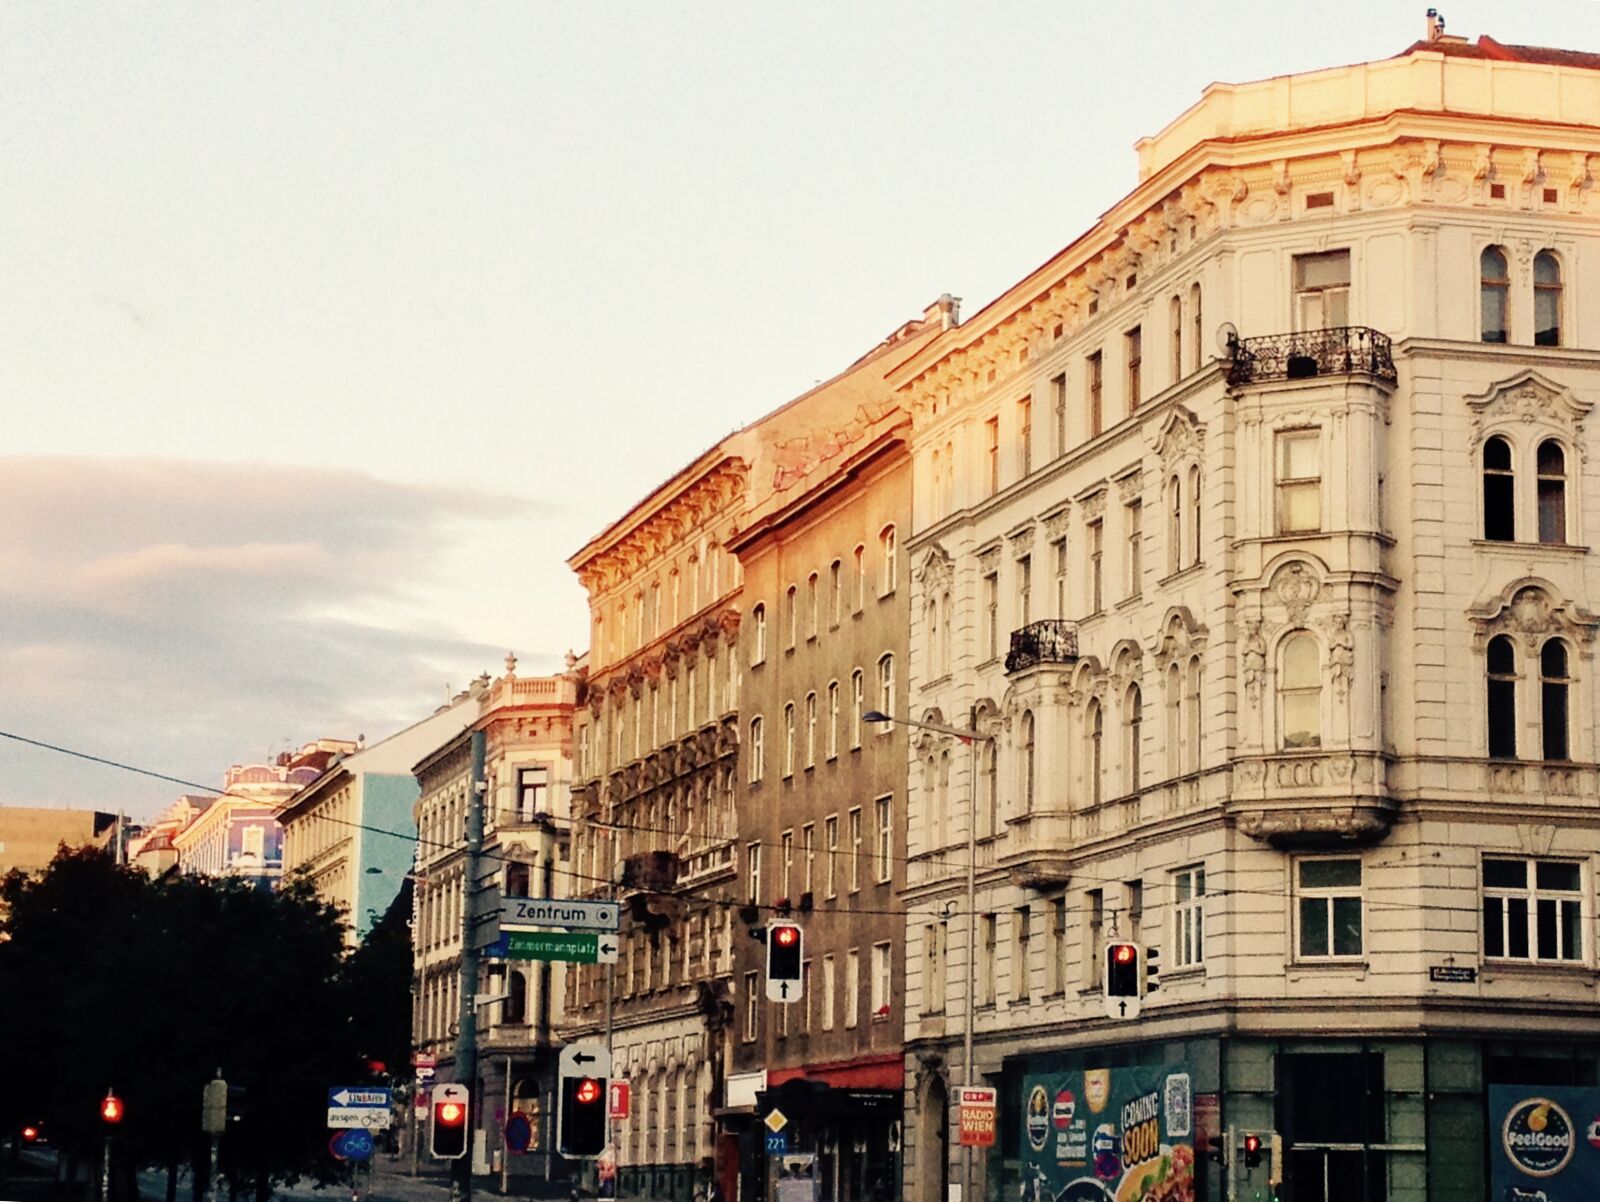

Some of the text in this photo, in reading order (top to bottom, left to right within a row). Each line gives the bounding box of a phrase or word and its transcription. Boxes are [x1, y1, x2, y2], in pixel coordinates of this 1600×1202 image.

[516, 903, 586, 921] Zentrum
[962, 1109, 994, 1120] RADIO
[1124, 1092, 1158, 1128] COMING
[962, 1120, 994, 1132] WIEN
[767, 1138, 785, 1150] 221
[1124, 1117, 1159, 1165] SOON
